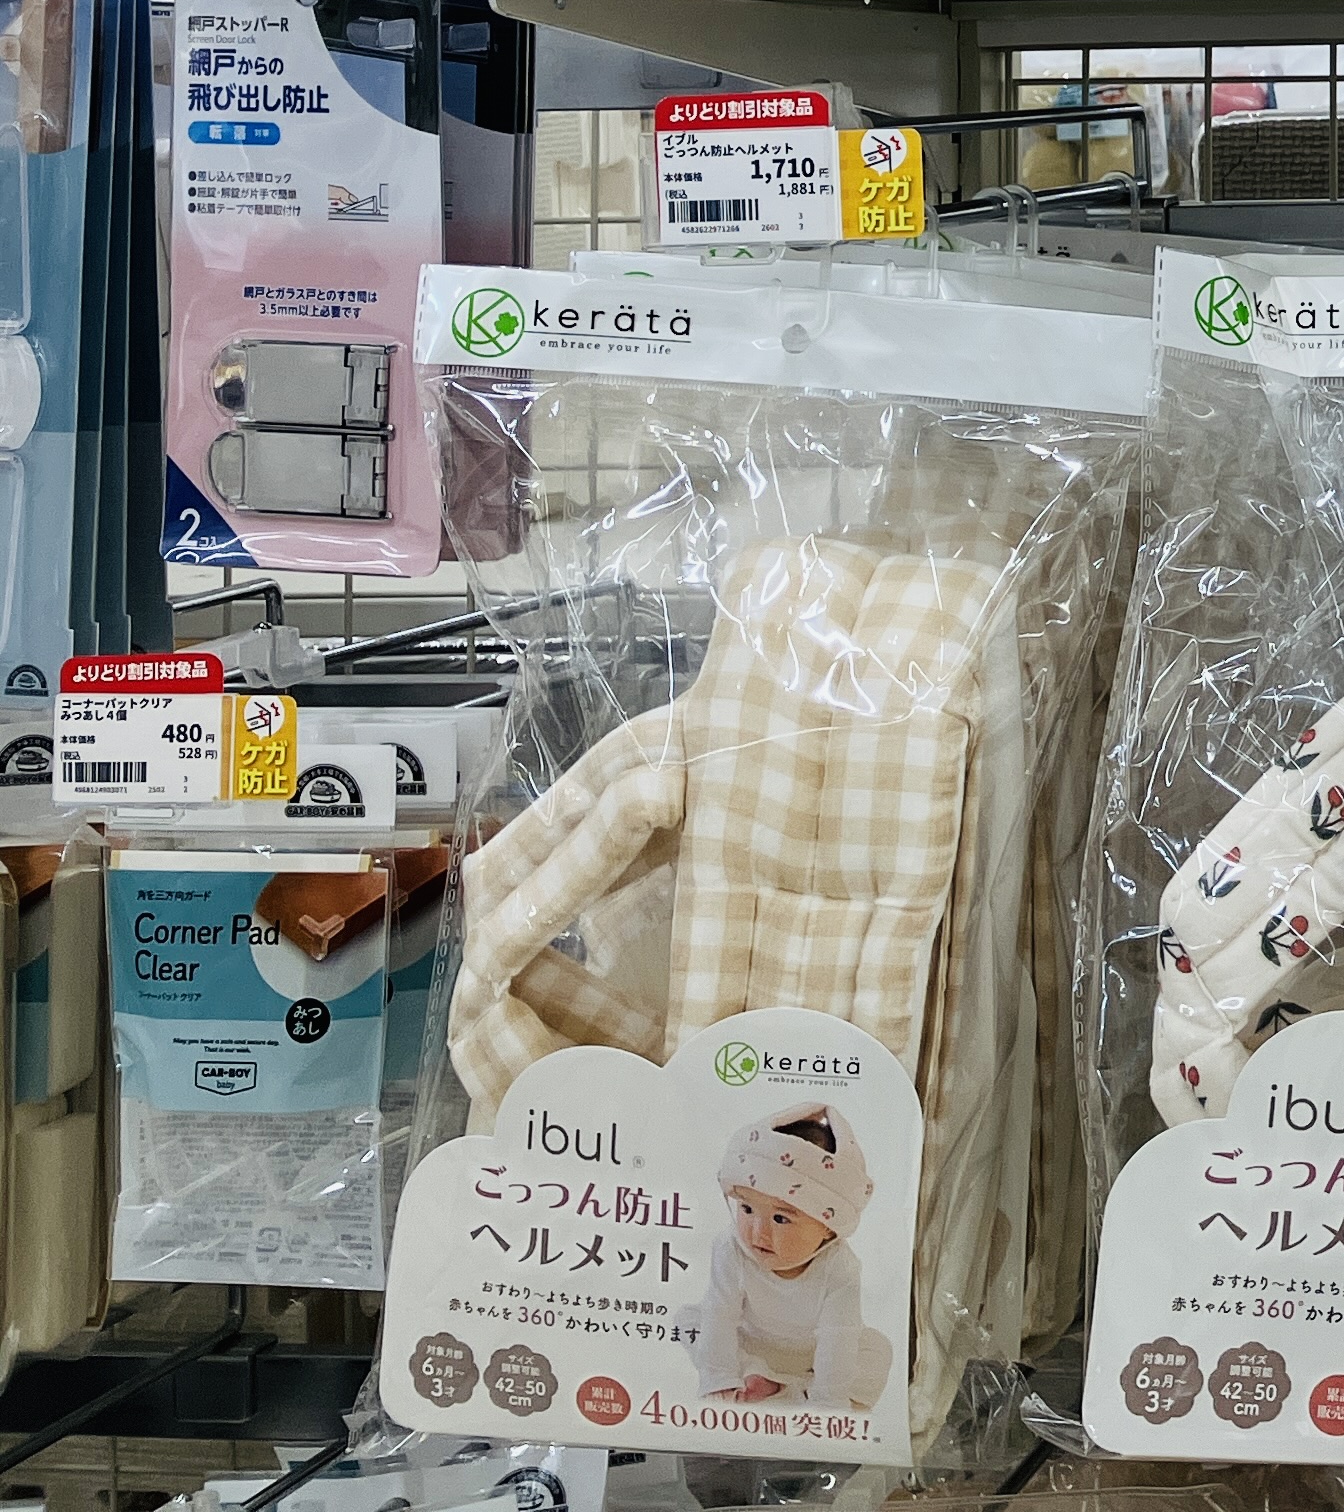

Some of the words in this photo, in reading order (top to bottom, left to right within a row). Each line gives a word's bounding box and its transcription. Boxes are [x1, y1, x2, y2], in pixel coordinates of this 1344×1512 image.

[188, 16, 289, 32] 網戸ストッパーR
[189, 48, 284, 77] 網戸からの
[189, 83, 330, 113] 飛び出し防止
[669, 98, 813, 122] よりどり割引対象品
[664, 134, 698, 146] イブル
[664, 144, 793, 158] ごっつん防止ヘルメット
[664, 173, 702, 182] 本体価格
[751, 158, 815, 184] 1,710
[778, 183, 816, 196] 1,881
[859, 178, 912, 203] ケガ
[858, 207, 915, 233] 防止
[533, 301, 691, 338] kerätä
[72, 660, 208, 683] よりどり割引対象品
[61, 735, 96, 745] 本体価格
[162, 724, 202, 743] 480
[178, 748, 201, 759] 528
[240, 741, 288, 765] ケガ
[239, 769, 288, 795] 防止
[135, 912, 223, 944] Corner
[231, 914, 280, 945] Pad
[135, 950, 200, 981] Clear
[294, 1005, 322, 1017] みつ
[292, 1022, 319, 1035] あし
[527, 1108, 621, 1165] ibul
[475, 1165, 694, 1230] ごっつん防止
[470, 1224, 689, 1282] ヘルメット
[1172, 1296, 1246, 1317] 赤ちゃんを
[508, 1394, 532, 1408] cm
[1234, 1399, 1260, 1418] cm
[639, 1390, 871, 1442] 40,000個突破!
